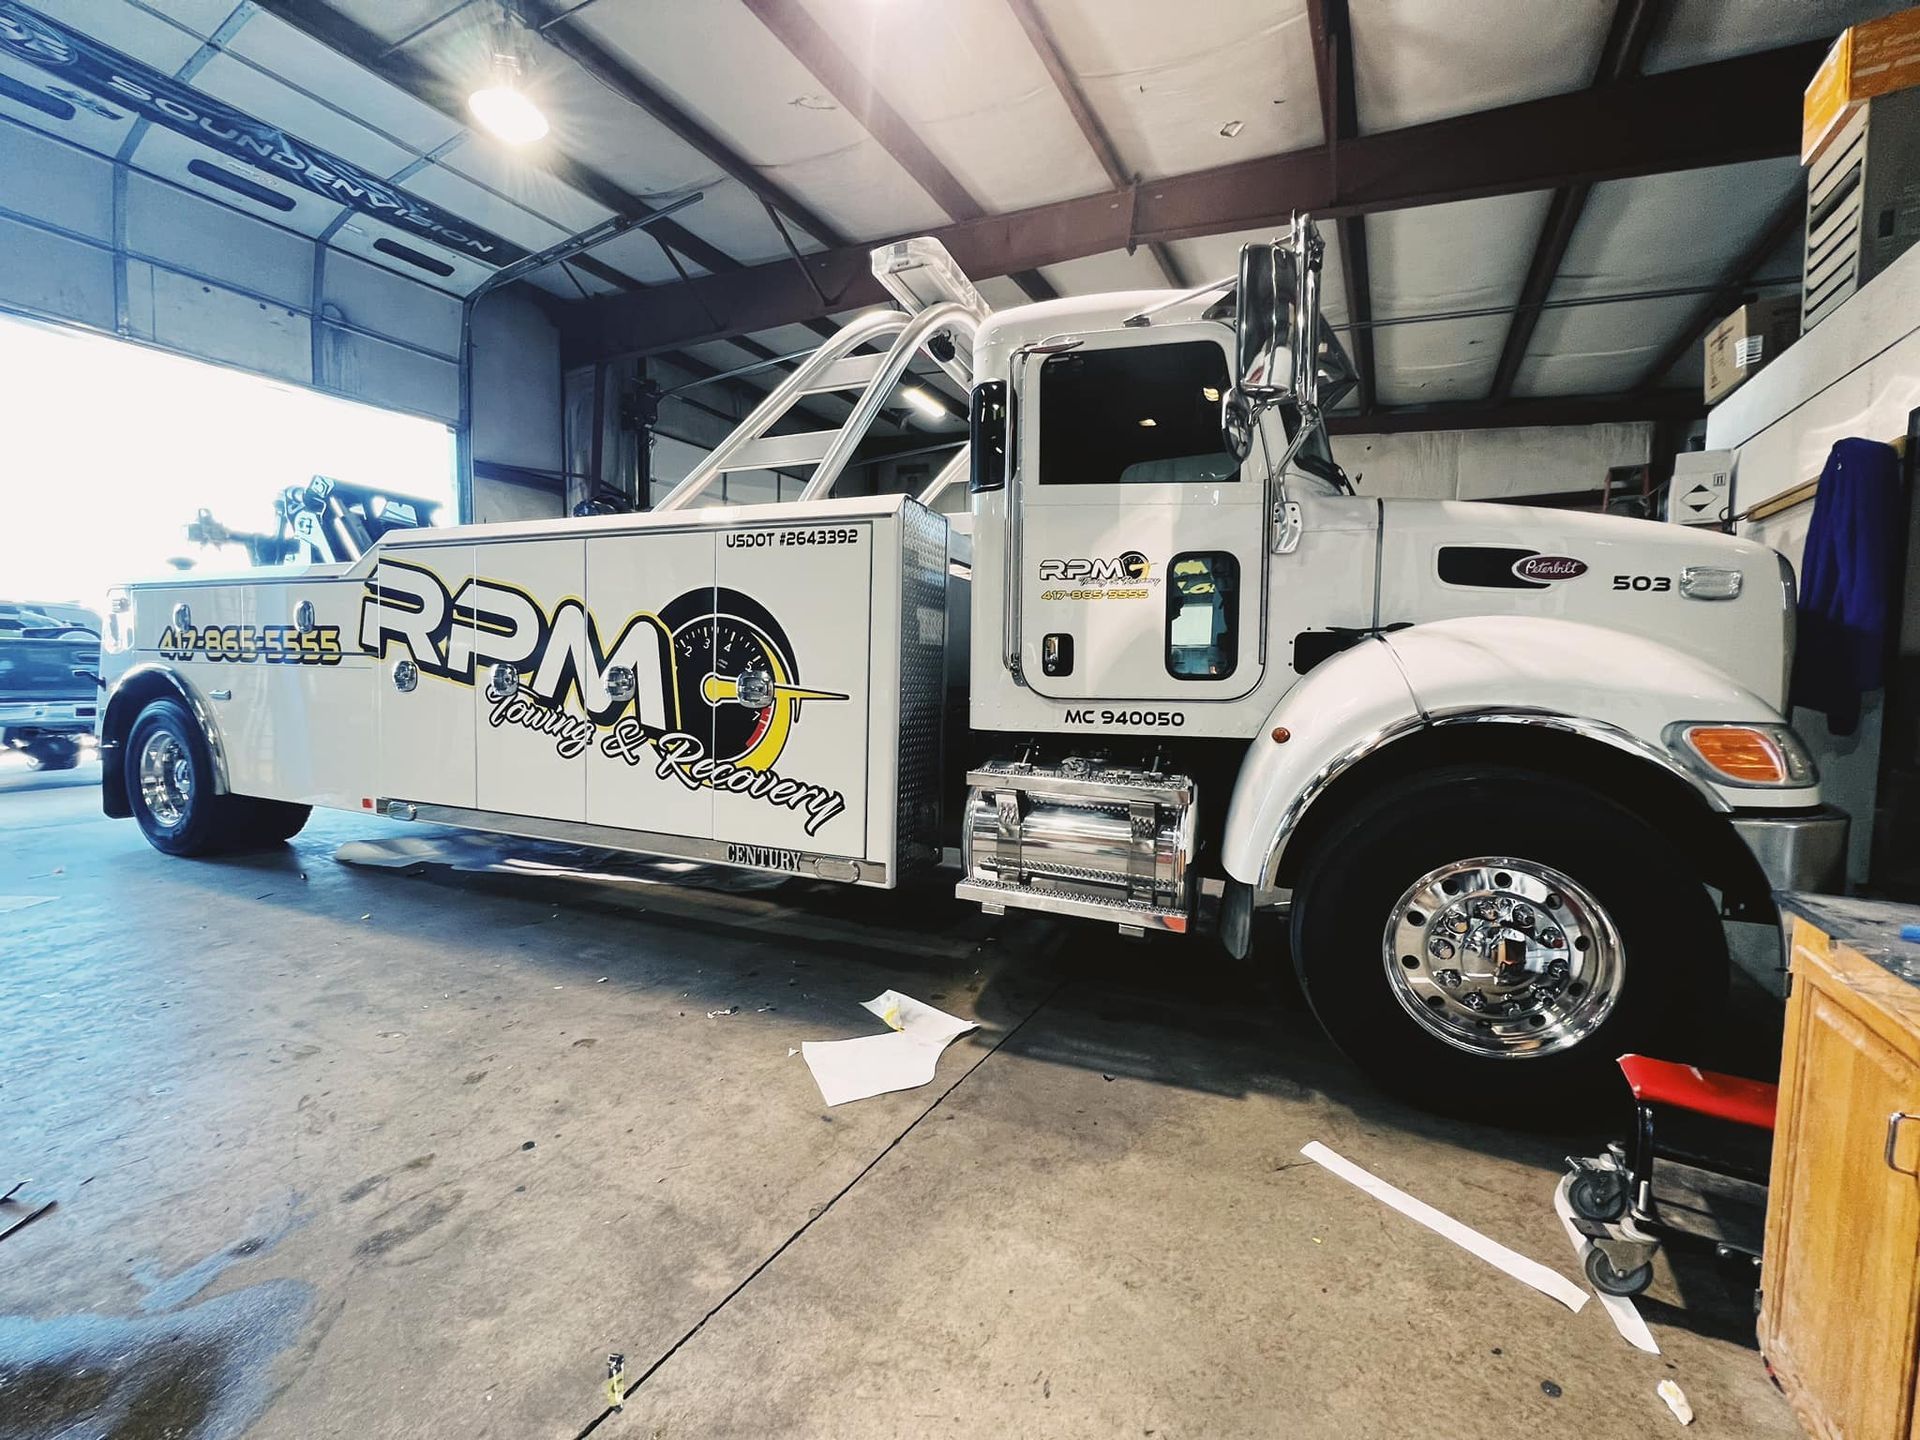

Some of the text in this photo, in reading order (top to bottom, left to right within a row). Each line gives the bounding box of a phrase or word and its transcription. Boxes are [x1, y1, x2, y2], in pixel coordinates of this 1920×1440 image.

[726, 529, 858, 548] USDOT #2643392
[1040, 558, 1125, 580] RPM
[1525, 559, 1582, 575] Peterbilt
[1612, 575, 1672, 592] 503
[1041, 589, 1149, 600] 417-865-5555
[159, 625, 343, 665] 417-865-5555
[360, 557, 677, 733] RPM
[684, 645, 693, 657] 2
[703, 638, 711, 649] 3
[1064, 709, 1185, 727] MC 940050
[487, 683, 845, 836] Towing & Recovery
[727, 843, 801, 872] CENTURY
